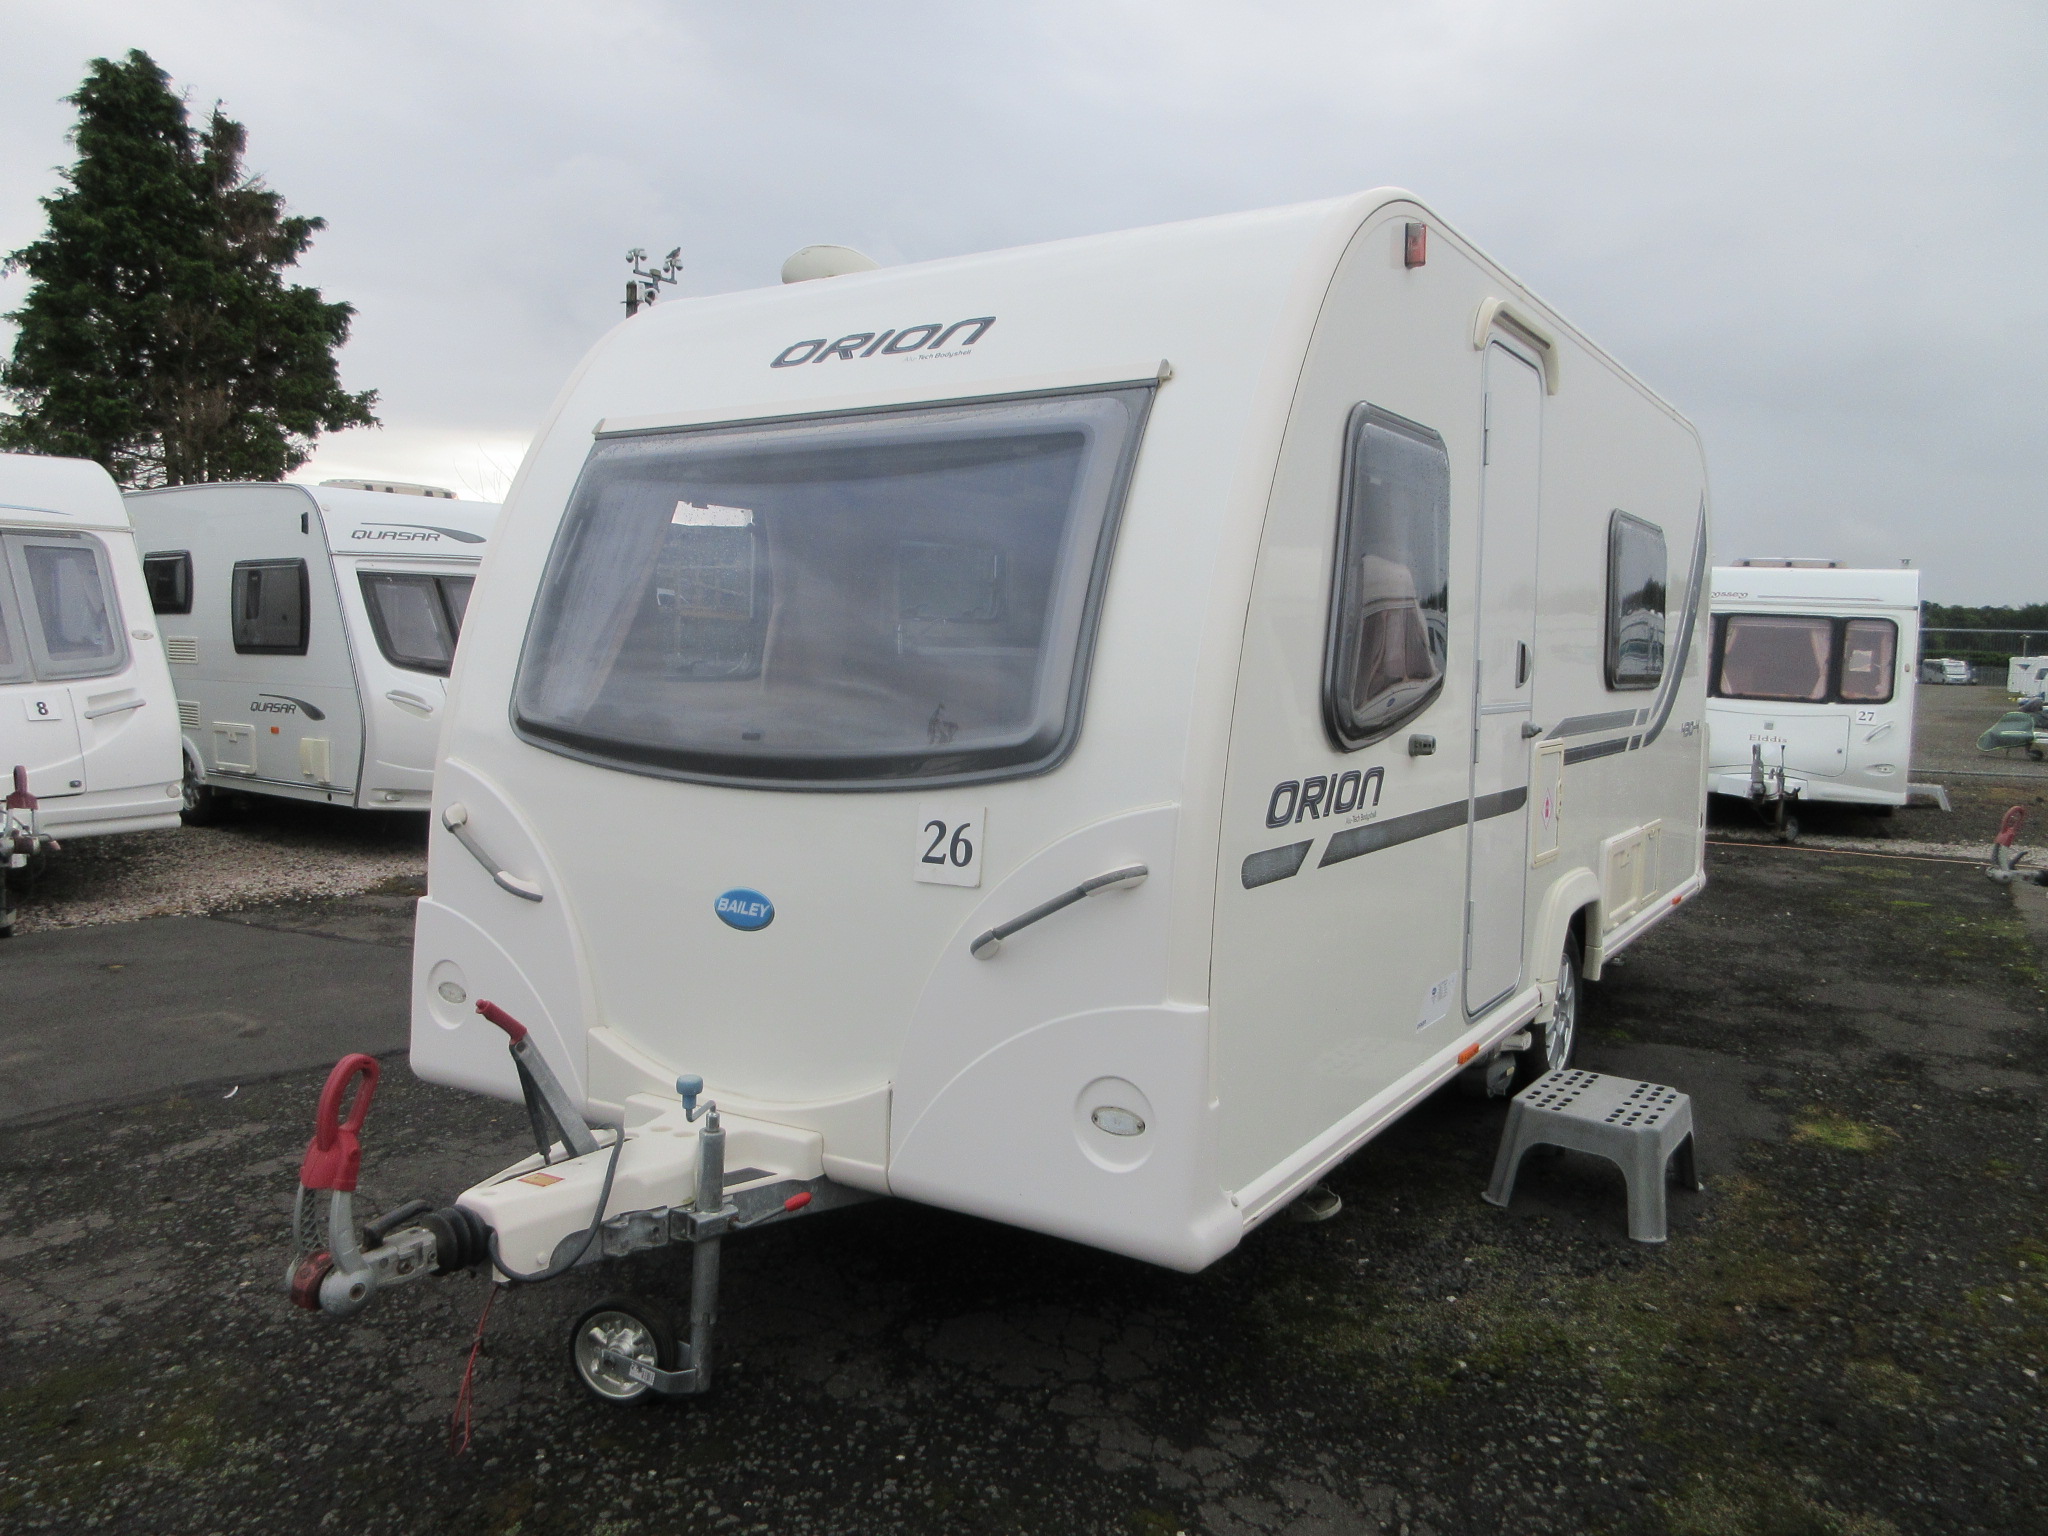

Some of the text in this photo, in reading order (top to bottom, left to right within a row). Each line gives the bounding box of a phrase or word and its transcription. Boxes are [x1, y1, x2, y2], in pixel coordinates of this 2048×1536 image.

[770, 316, 996, 368] ORION
[934, 349, 972, 359] Bodyshell
[351, 529, 441, 542] QUASAR
[36, 701, 49, 716] 8
[250, 701, 297, 715] QUASAR
[1858, 710, 1875, 722] 27
[1749, 734, 1788, 743] Elddis
[1265, 765, 1385, 829] ORION
[921, 820, 973, 867] 26
[718, 897, 771, 918] BAILEY
